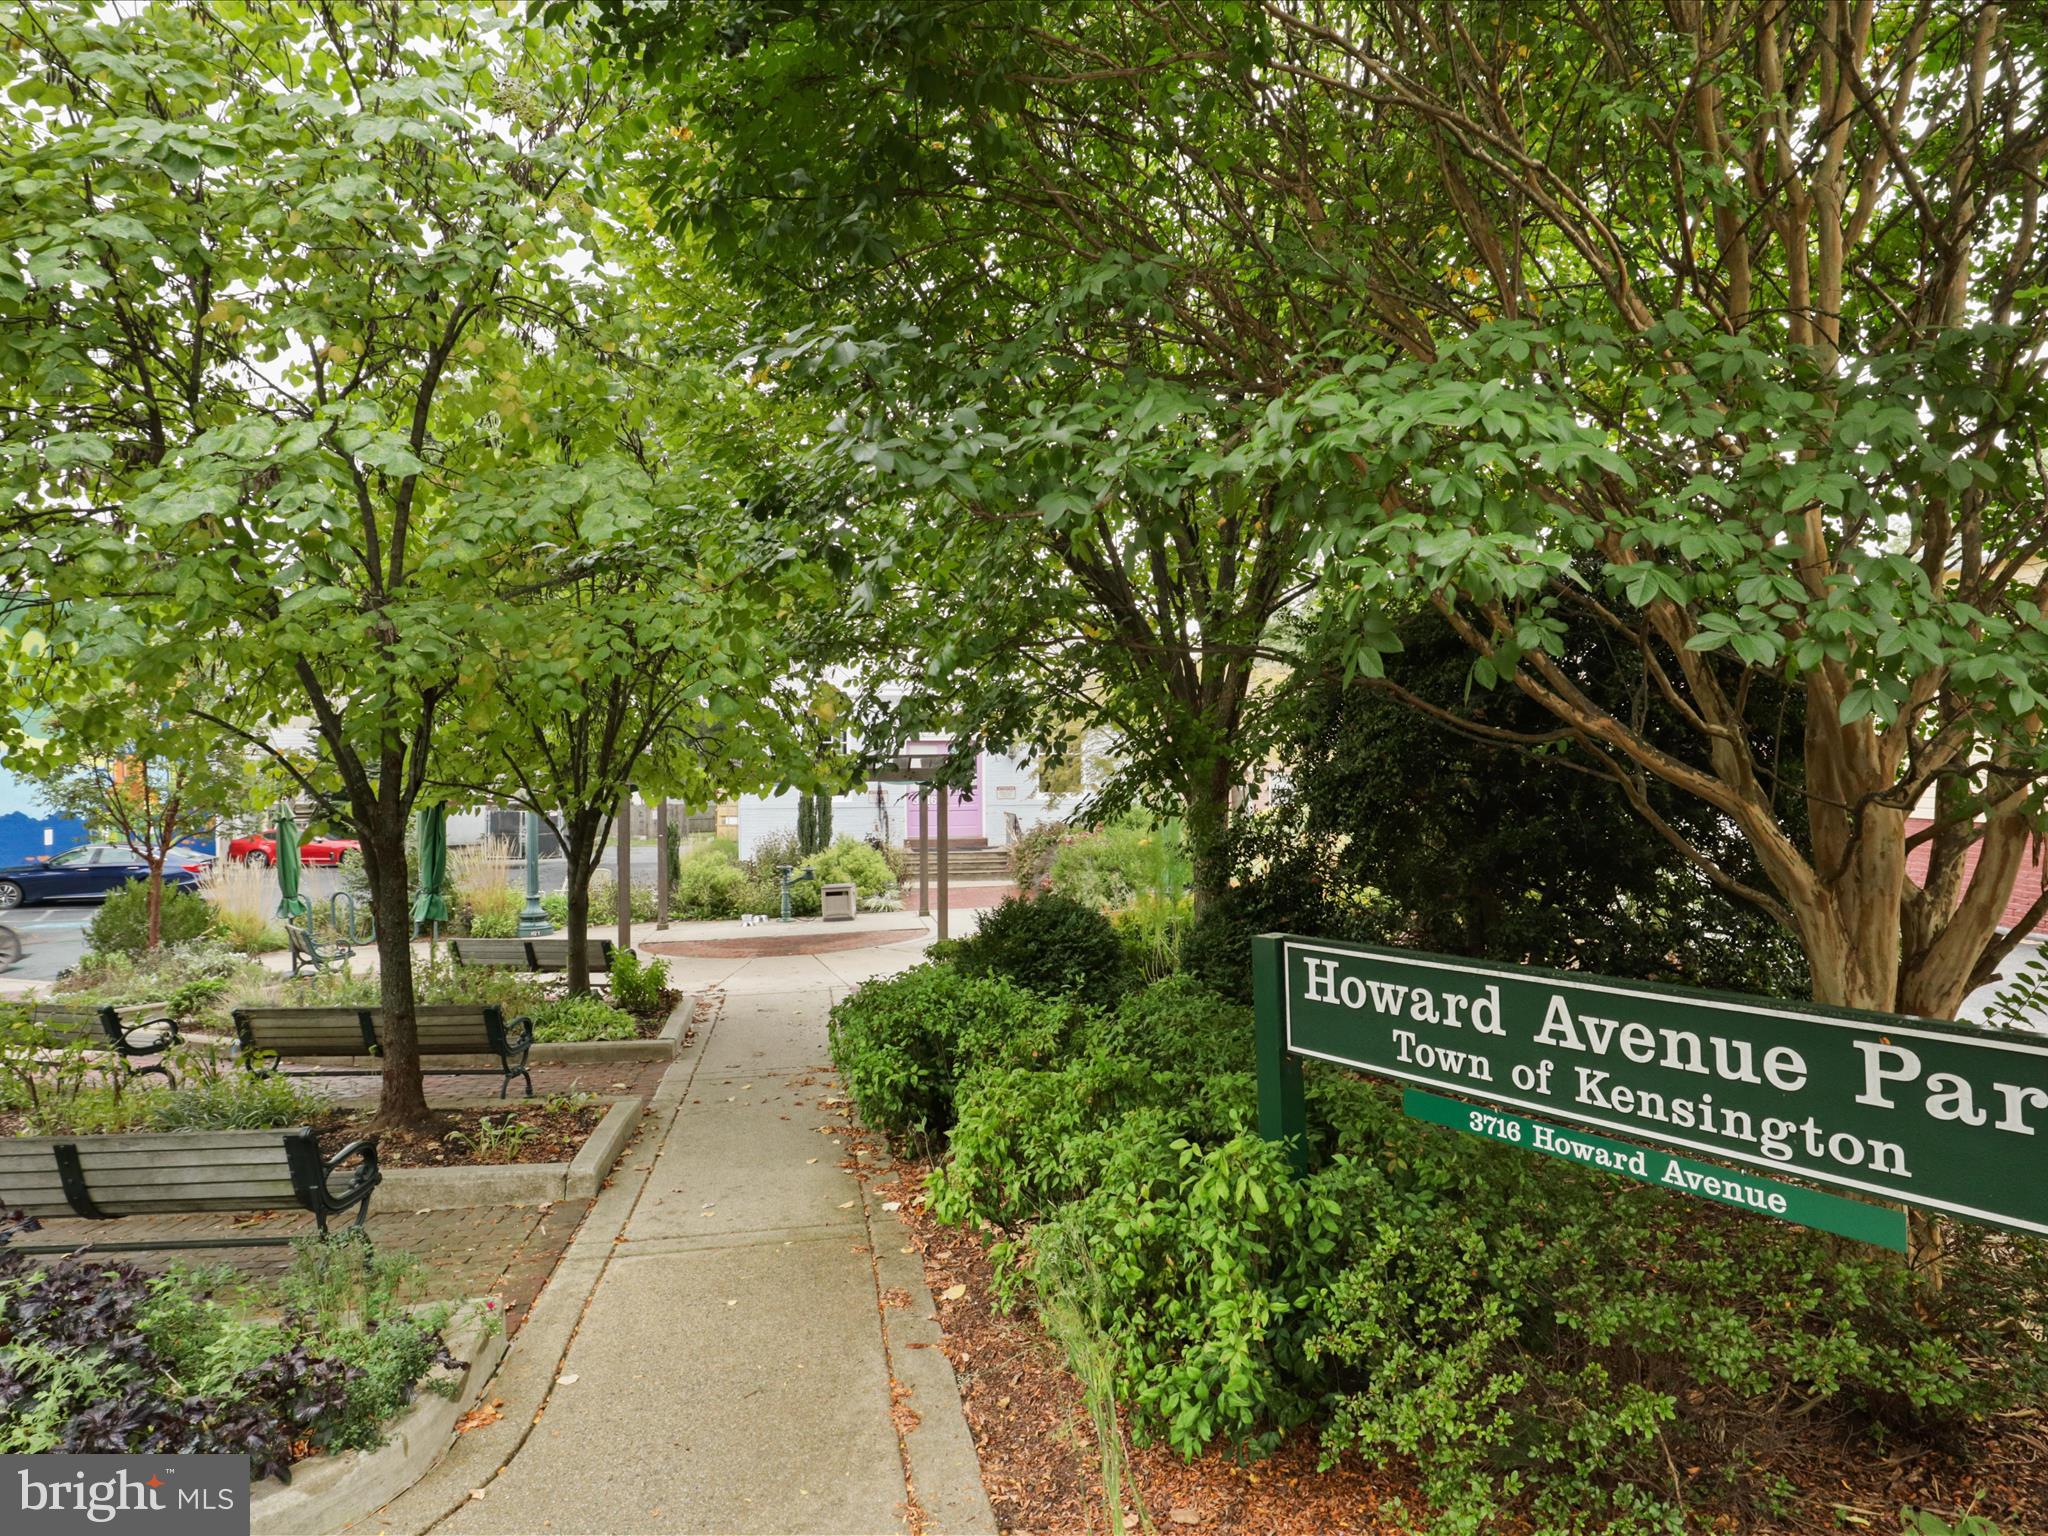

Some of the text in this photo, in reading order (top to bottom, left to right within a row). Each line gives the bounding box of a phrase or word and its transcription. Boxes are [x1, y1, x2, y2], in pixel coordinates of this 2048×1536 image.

[1303, 956, 1507, 1037] Howard
[1533, 994, 1808, 1092] Avenue
[1392, 1028, 1913, 1178] Town of Kensington
[1469, 1111, 1789, 1215] 3716 Howard Avenue
